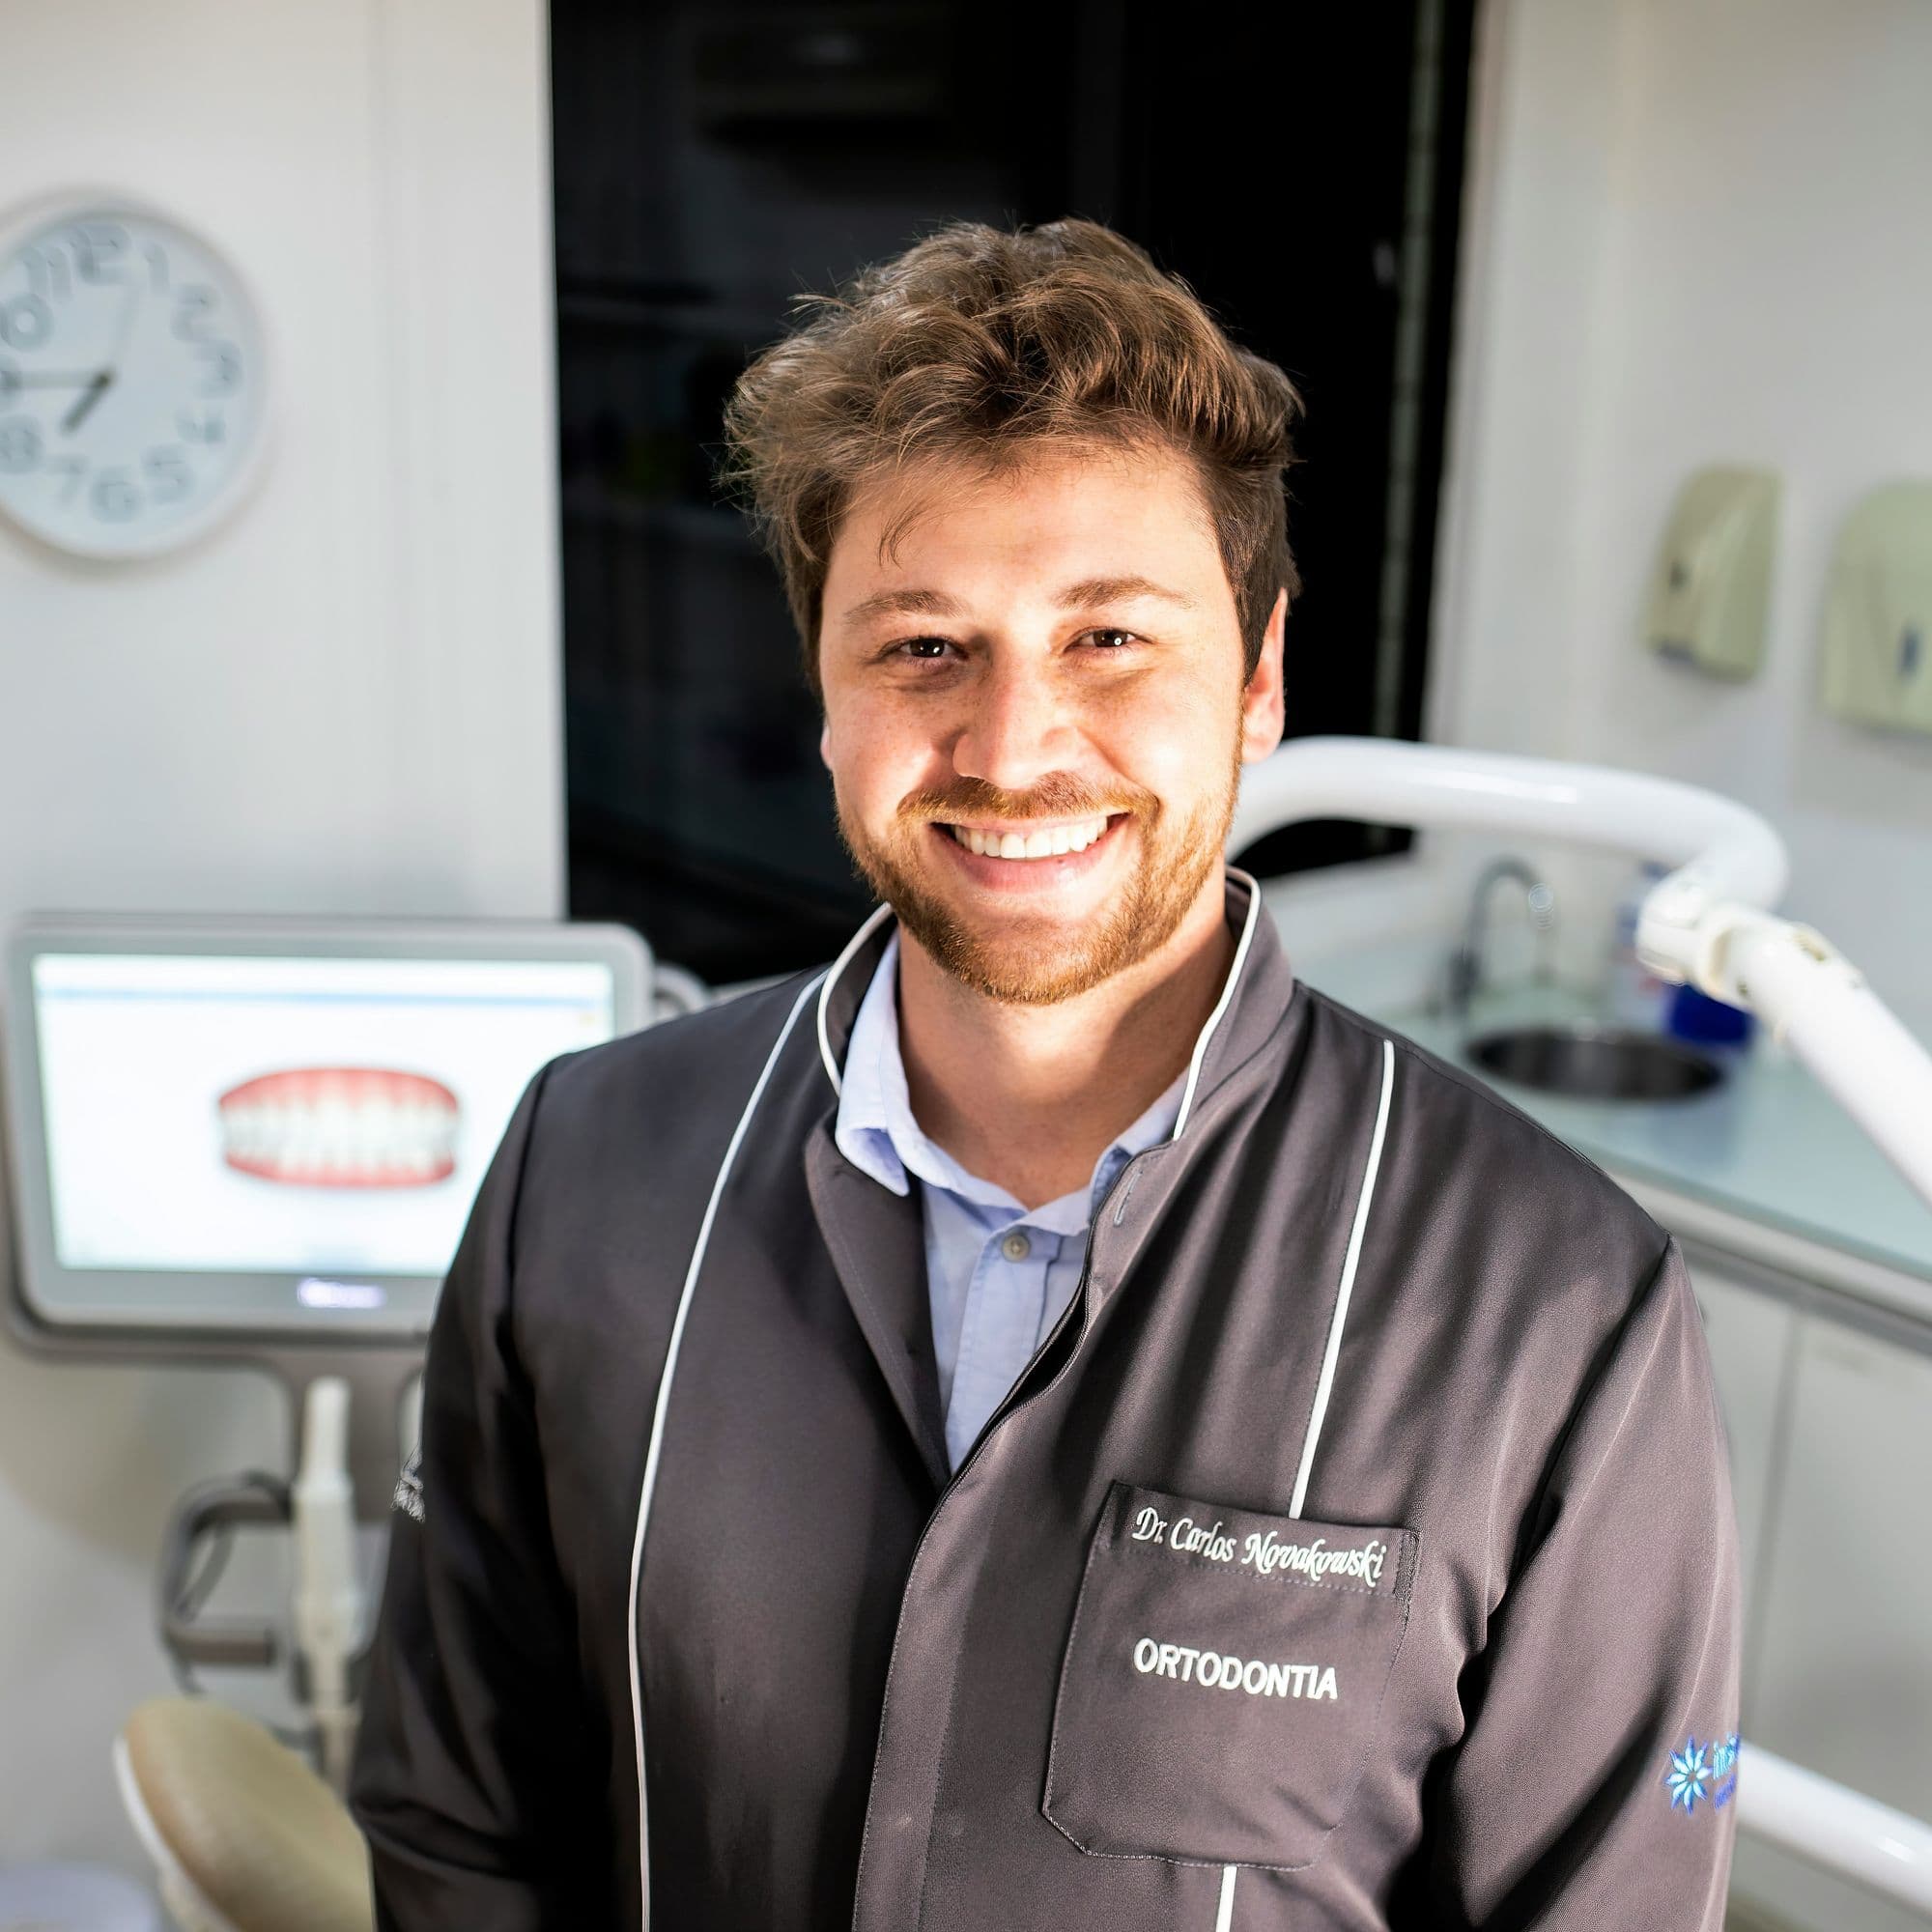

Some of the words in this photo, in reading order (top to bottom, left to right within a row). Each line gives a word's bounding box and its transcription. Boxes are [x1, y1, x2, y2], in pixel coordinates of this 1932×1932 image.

[172, 282, 218, 342] 2
[194, 340, 243, 398] 3
[1132, 1506, 1168, 1544] Dr.
[1170, 1518, 1237, 1562] Carlos
[1241, 1530, 1387, 1587] Novakowski
[1133, 1637, 1338, 1700] ORTODONTIA
